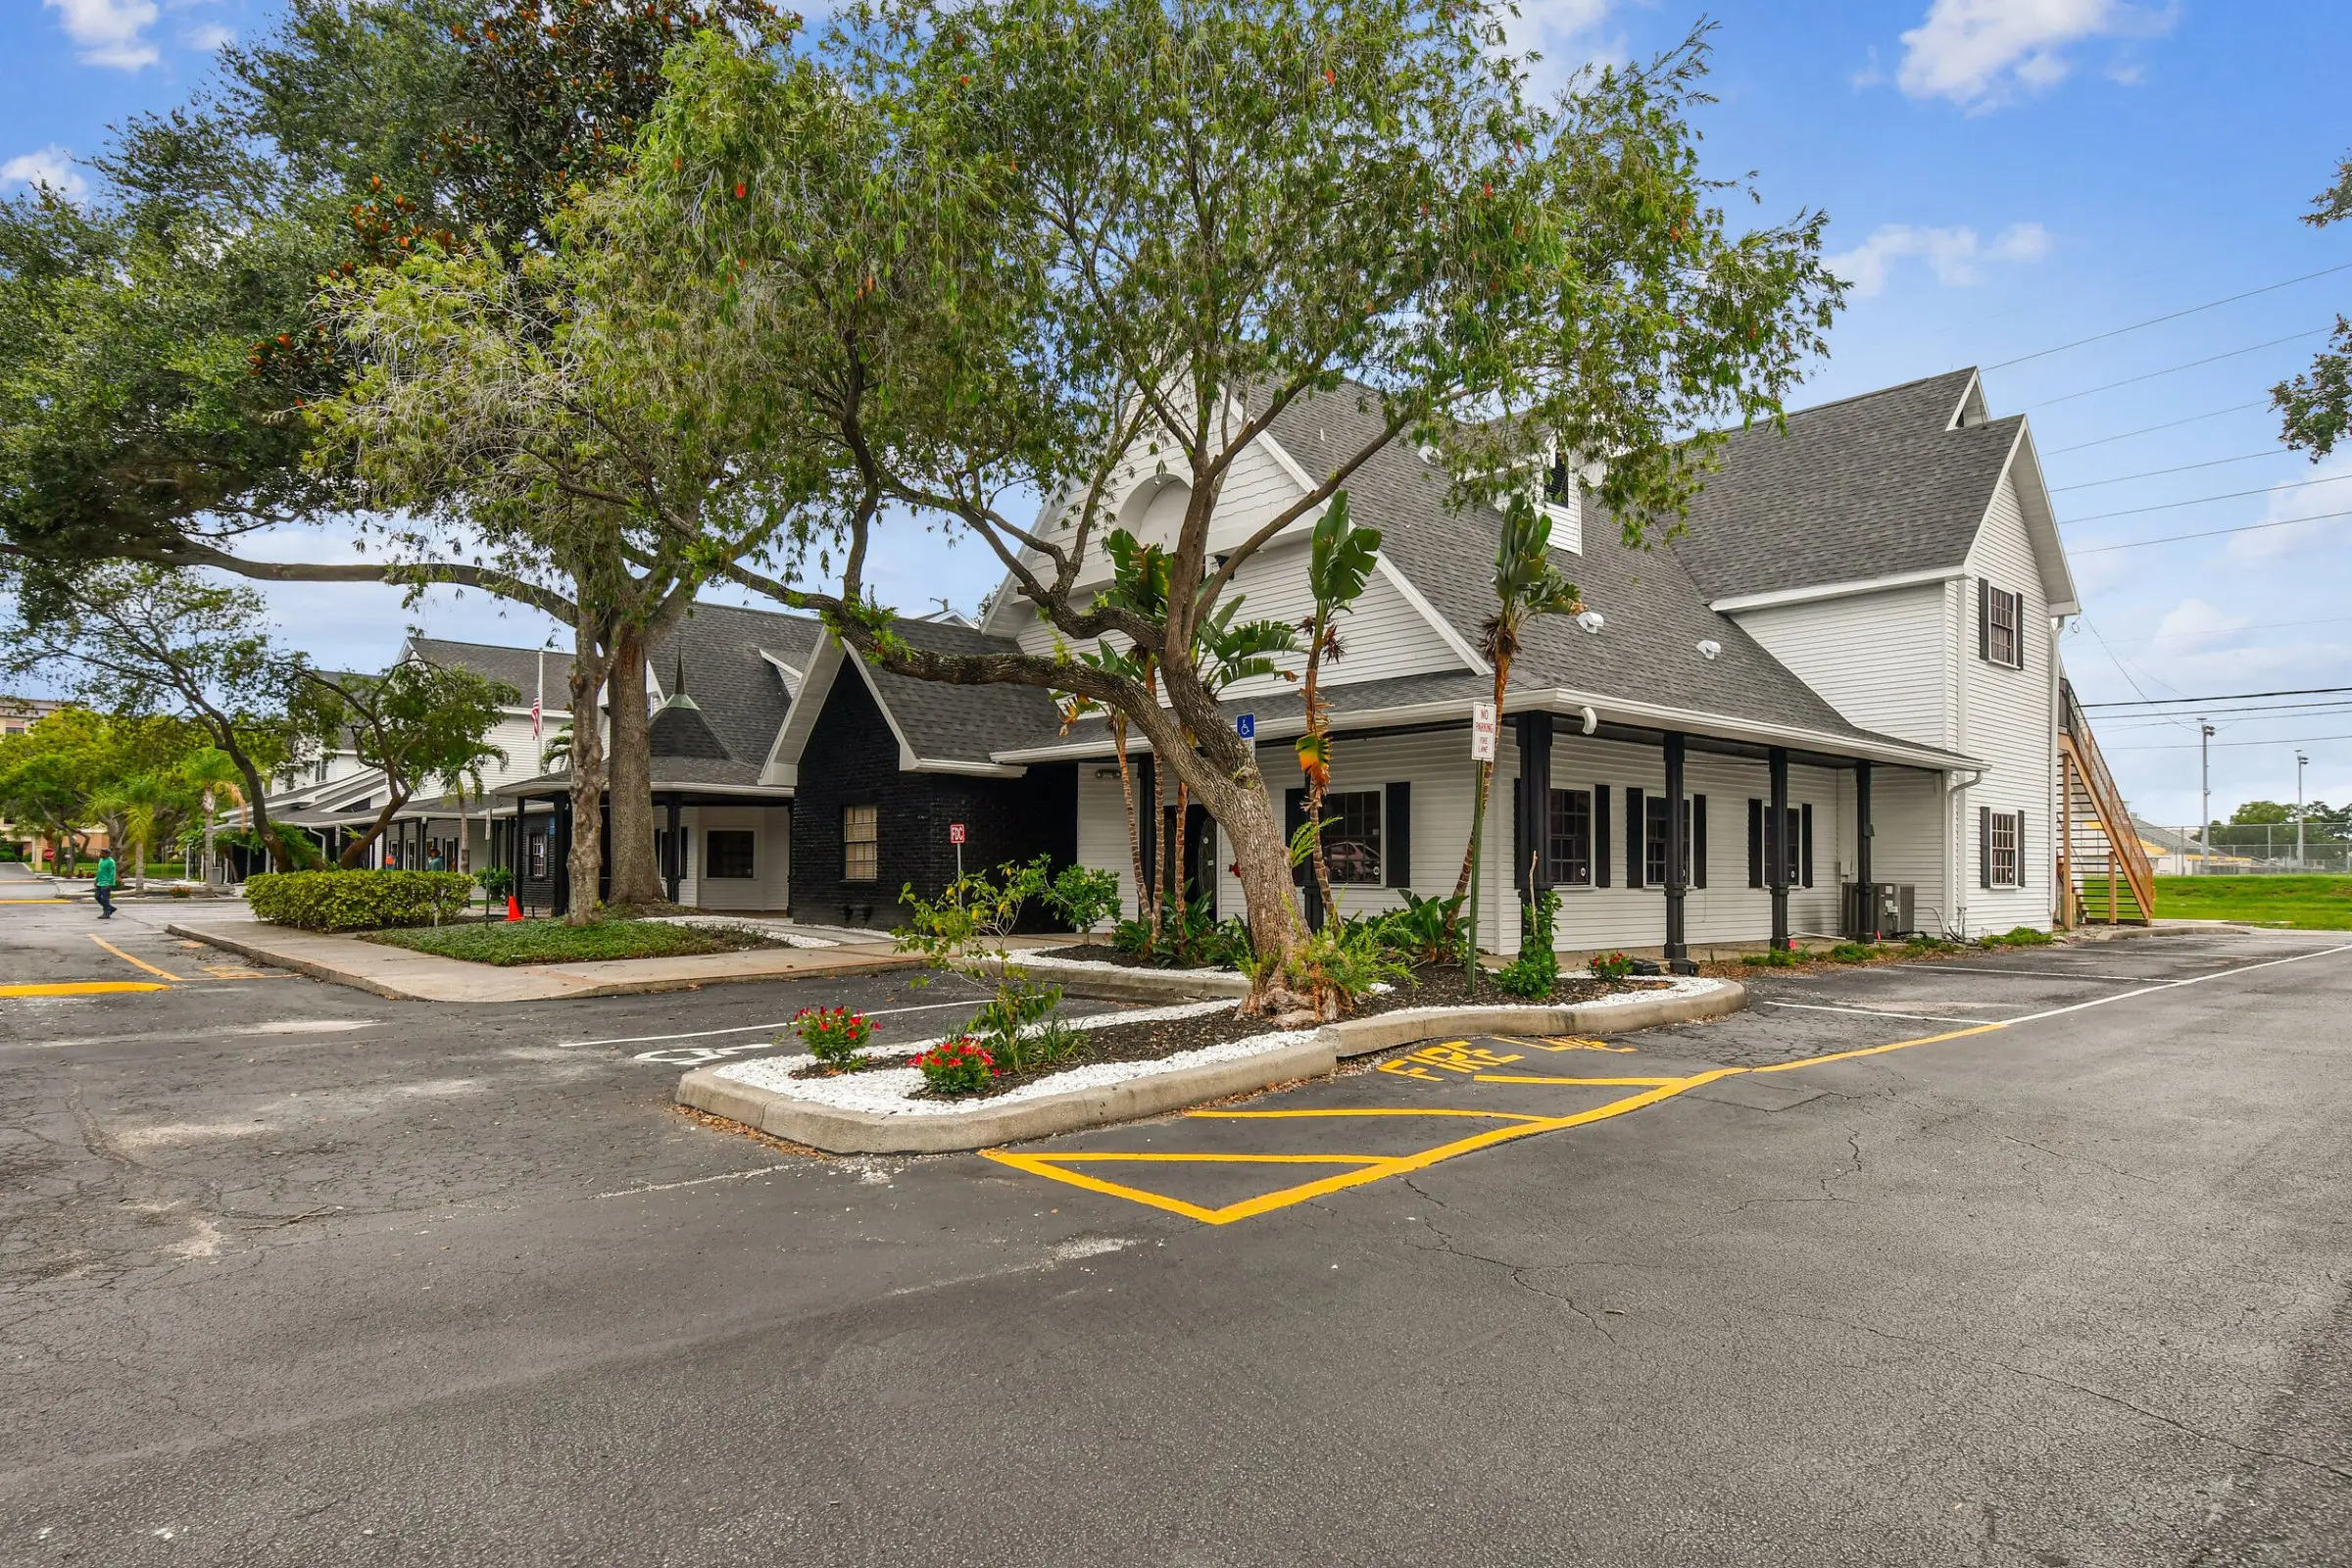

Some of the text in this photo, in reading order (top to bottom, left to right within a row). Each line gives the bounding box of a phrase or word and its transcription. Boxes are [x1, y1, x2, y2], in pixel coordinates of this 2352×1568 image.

[1481, 709, 1489, 720] NO
[1475, 722, 1494, 733] PARKING
[952, 826, 963, 841] FDC
[1376, 1039, 1526, 1082] FIRE
